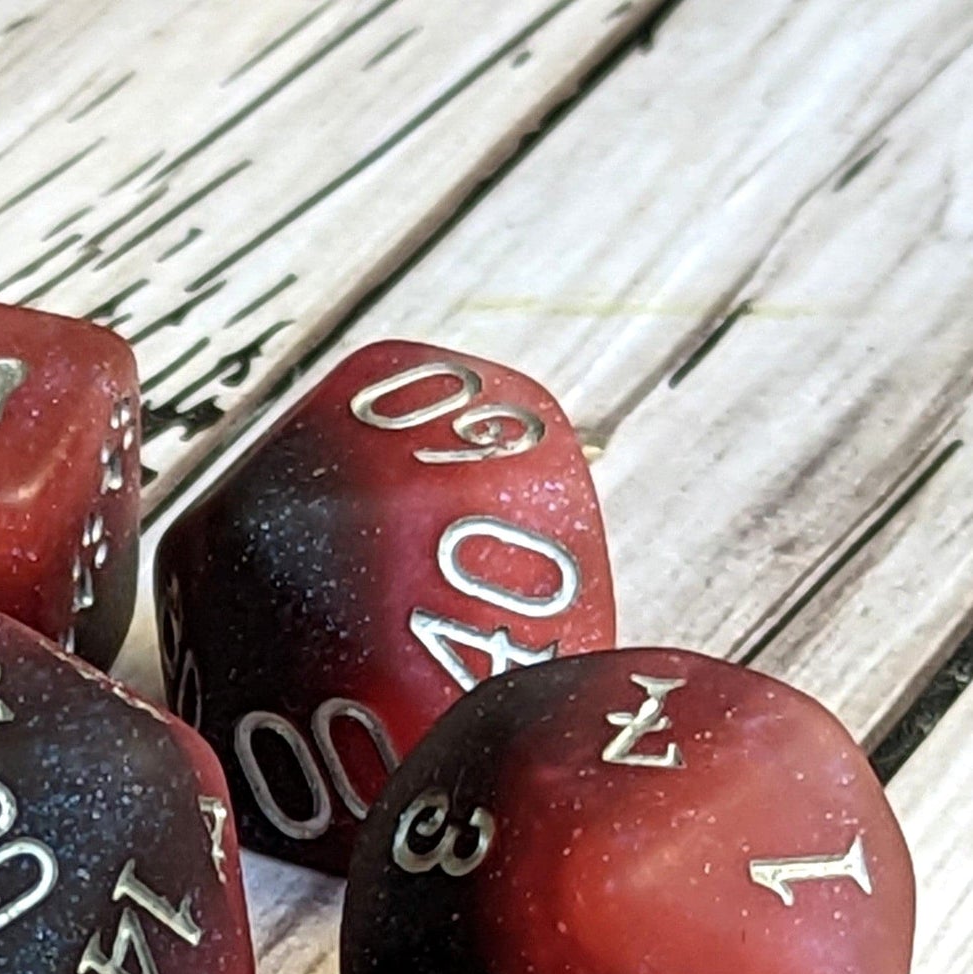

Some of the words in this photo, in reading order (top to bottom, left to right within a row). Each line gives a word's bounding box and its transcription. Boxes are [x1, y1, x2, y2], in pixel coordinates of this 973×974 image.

[409, 514, 582, 693] 40
[233, 697, 400, 840] 00
[391, 792, 497, 878] 3
[749, 836, 873, 906] 1
